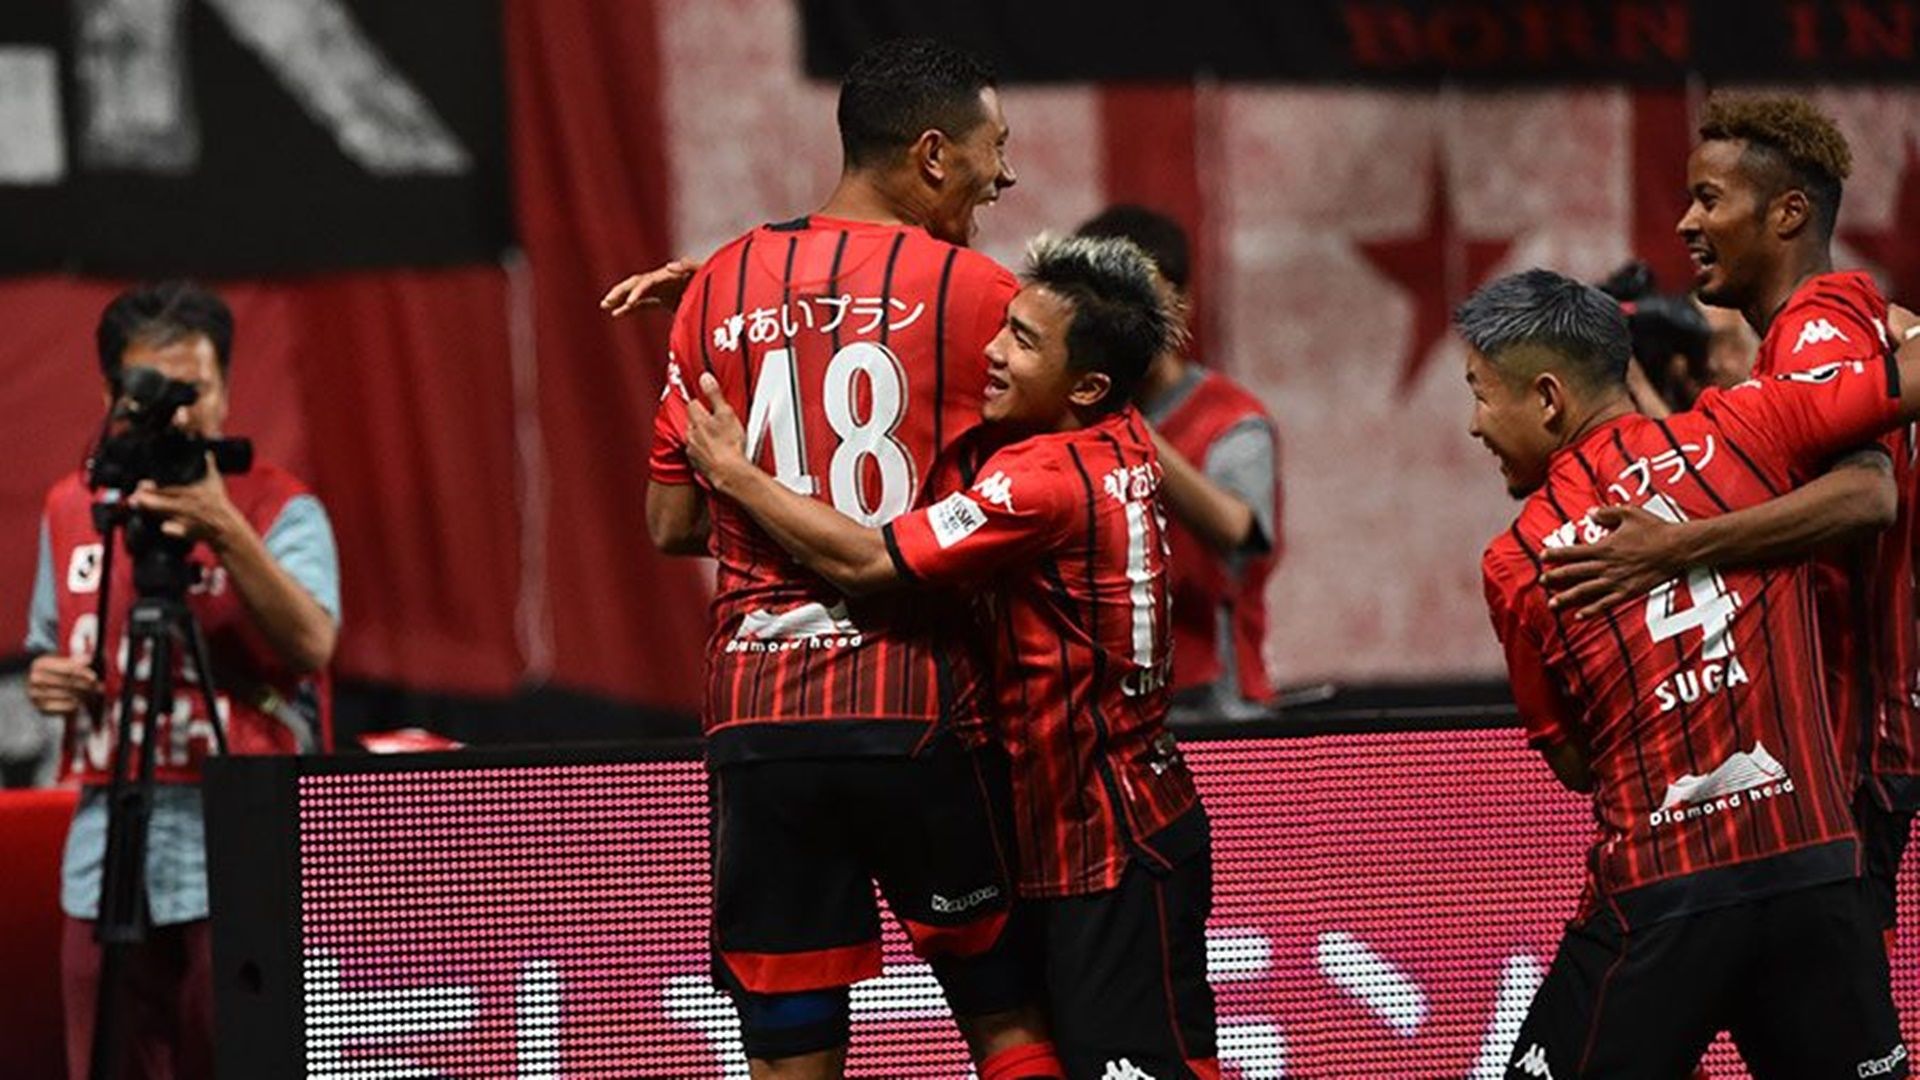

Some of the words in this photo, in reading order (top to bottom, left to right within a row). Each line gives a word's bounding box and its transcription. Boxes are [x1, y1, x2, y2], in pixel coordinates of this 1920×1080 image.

[1341, 0, 1692, 67] BORN
[1787, 0, 1917, 63] IN
[747, 294, 926, 344] あいプラン
[745, 340, 919, 528] 48
[1643, 493, 1742, 661] 4
[809, 633, 863, 649] head
[1654, 655, 1749, 712] SUGA
[1650, 793, 1742, 827] Diamond
[1749, 778, 1795, 802] head
